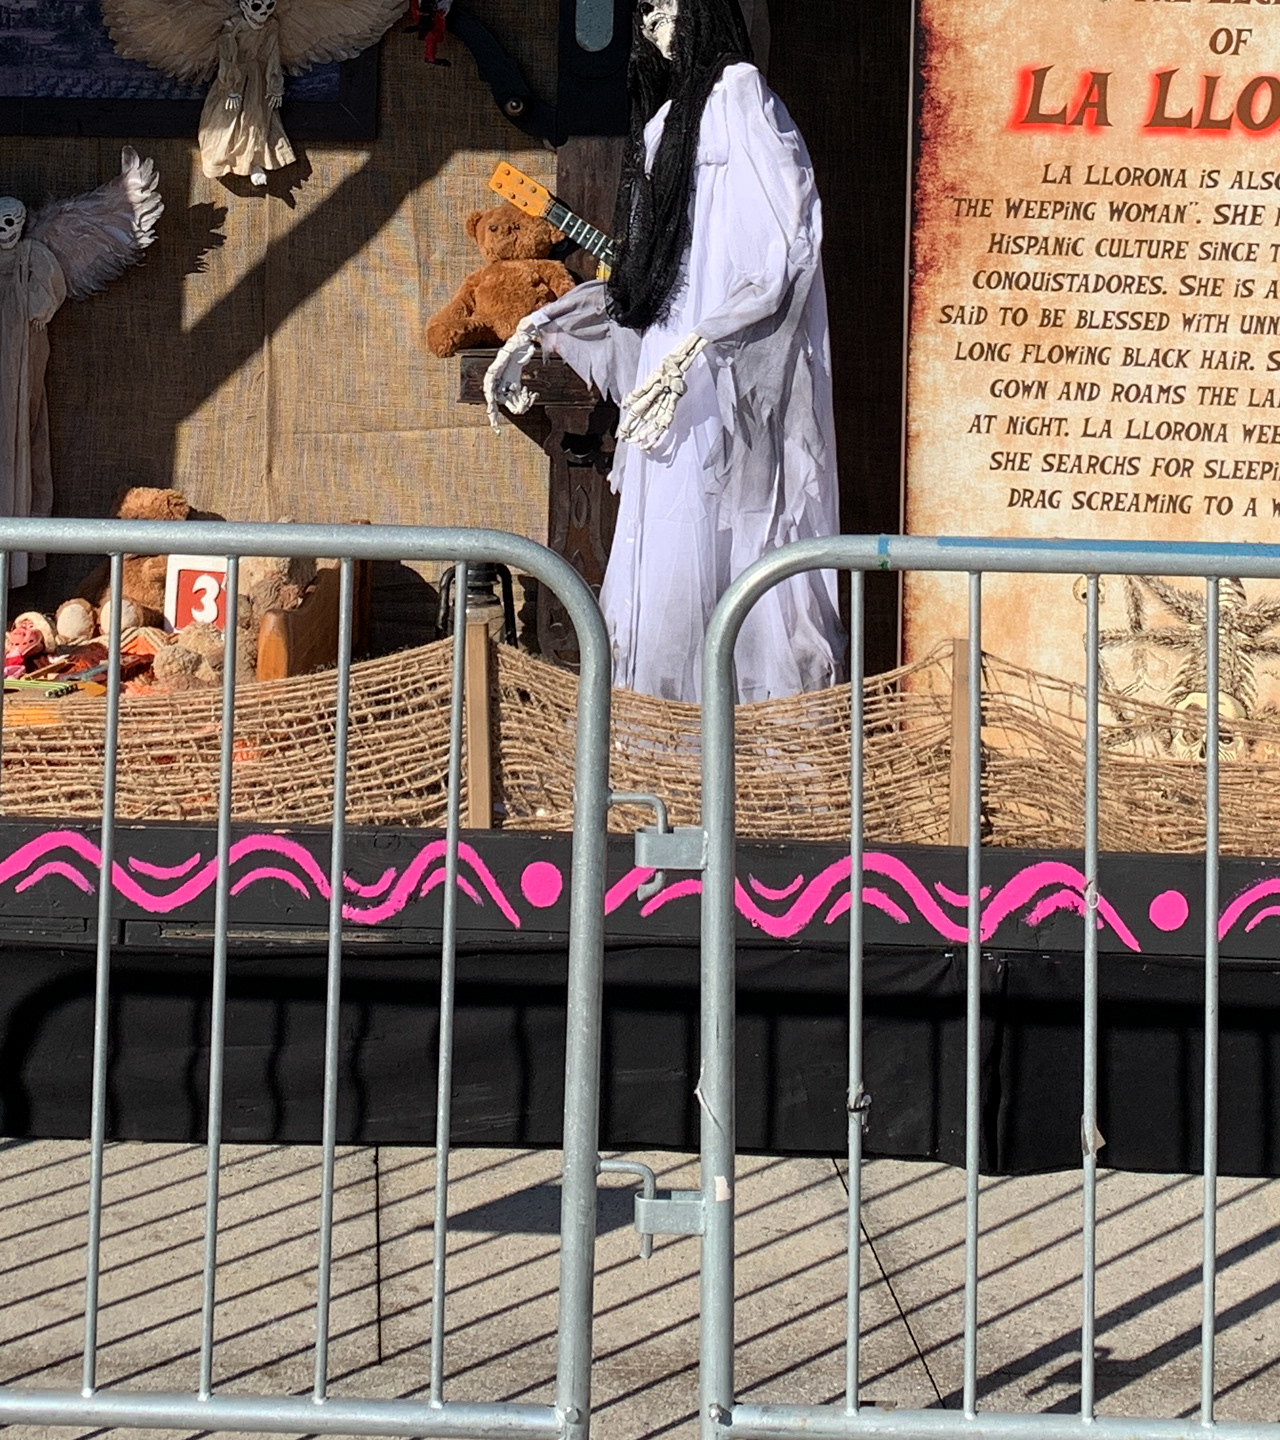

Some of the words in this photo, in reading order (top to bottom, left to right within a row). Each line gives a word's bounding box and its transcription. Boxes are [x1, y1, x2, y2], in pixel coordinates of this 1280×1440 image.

[1208, 27, 1253, 56] OF
[1020, 64, 1114, 128] LA
[1041, 163, 1072, 185] LA
[1084, 164, 1188, 189] LLORONA
[1212, 203, 1266, 227] SHE
[1094, 237, 1190, 260] CULTURE
[1178, 274, 1225, 298] SHE
[1263, 279, 1279, 300] A
[998, 306, 1029, 327] TO
[1038, 308, 1067, 328] BE
[1074, 309, 1170, 332] BLESSED
[954, 341, 1012, 363] LONG
[1120, 346, 1192, 369] BLACK
[989, 378, 1049, 400] GOWN
[1056, 381, 1101, 402] AND
[1110, 382, 1187, 405] ROAMS
[1197, 385, 1239, 407] THE
[967, 414, 998, 434] AT
[1080, 417, 1113, 439] LA
[1124, 418, 1228, 443] LLORONA
[989, 451, 1033, 472] SHE
[1041, 453, 1142, 476] SEARCHS
[1150, 457, 1195, 478] FOR
[1007, 487, 1063, 510] DRAG
[1203, 495, 1234, 516] TO
[1242, 497, 1258, 517] A
[191, 574, 227, 624] 3
